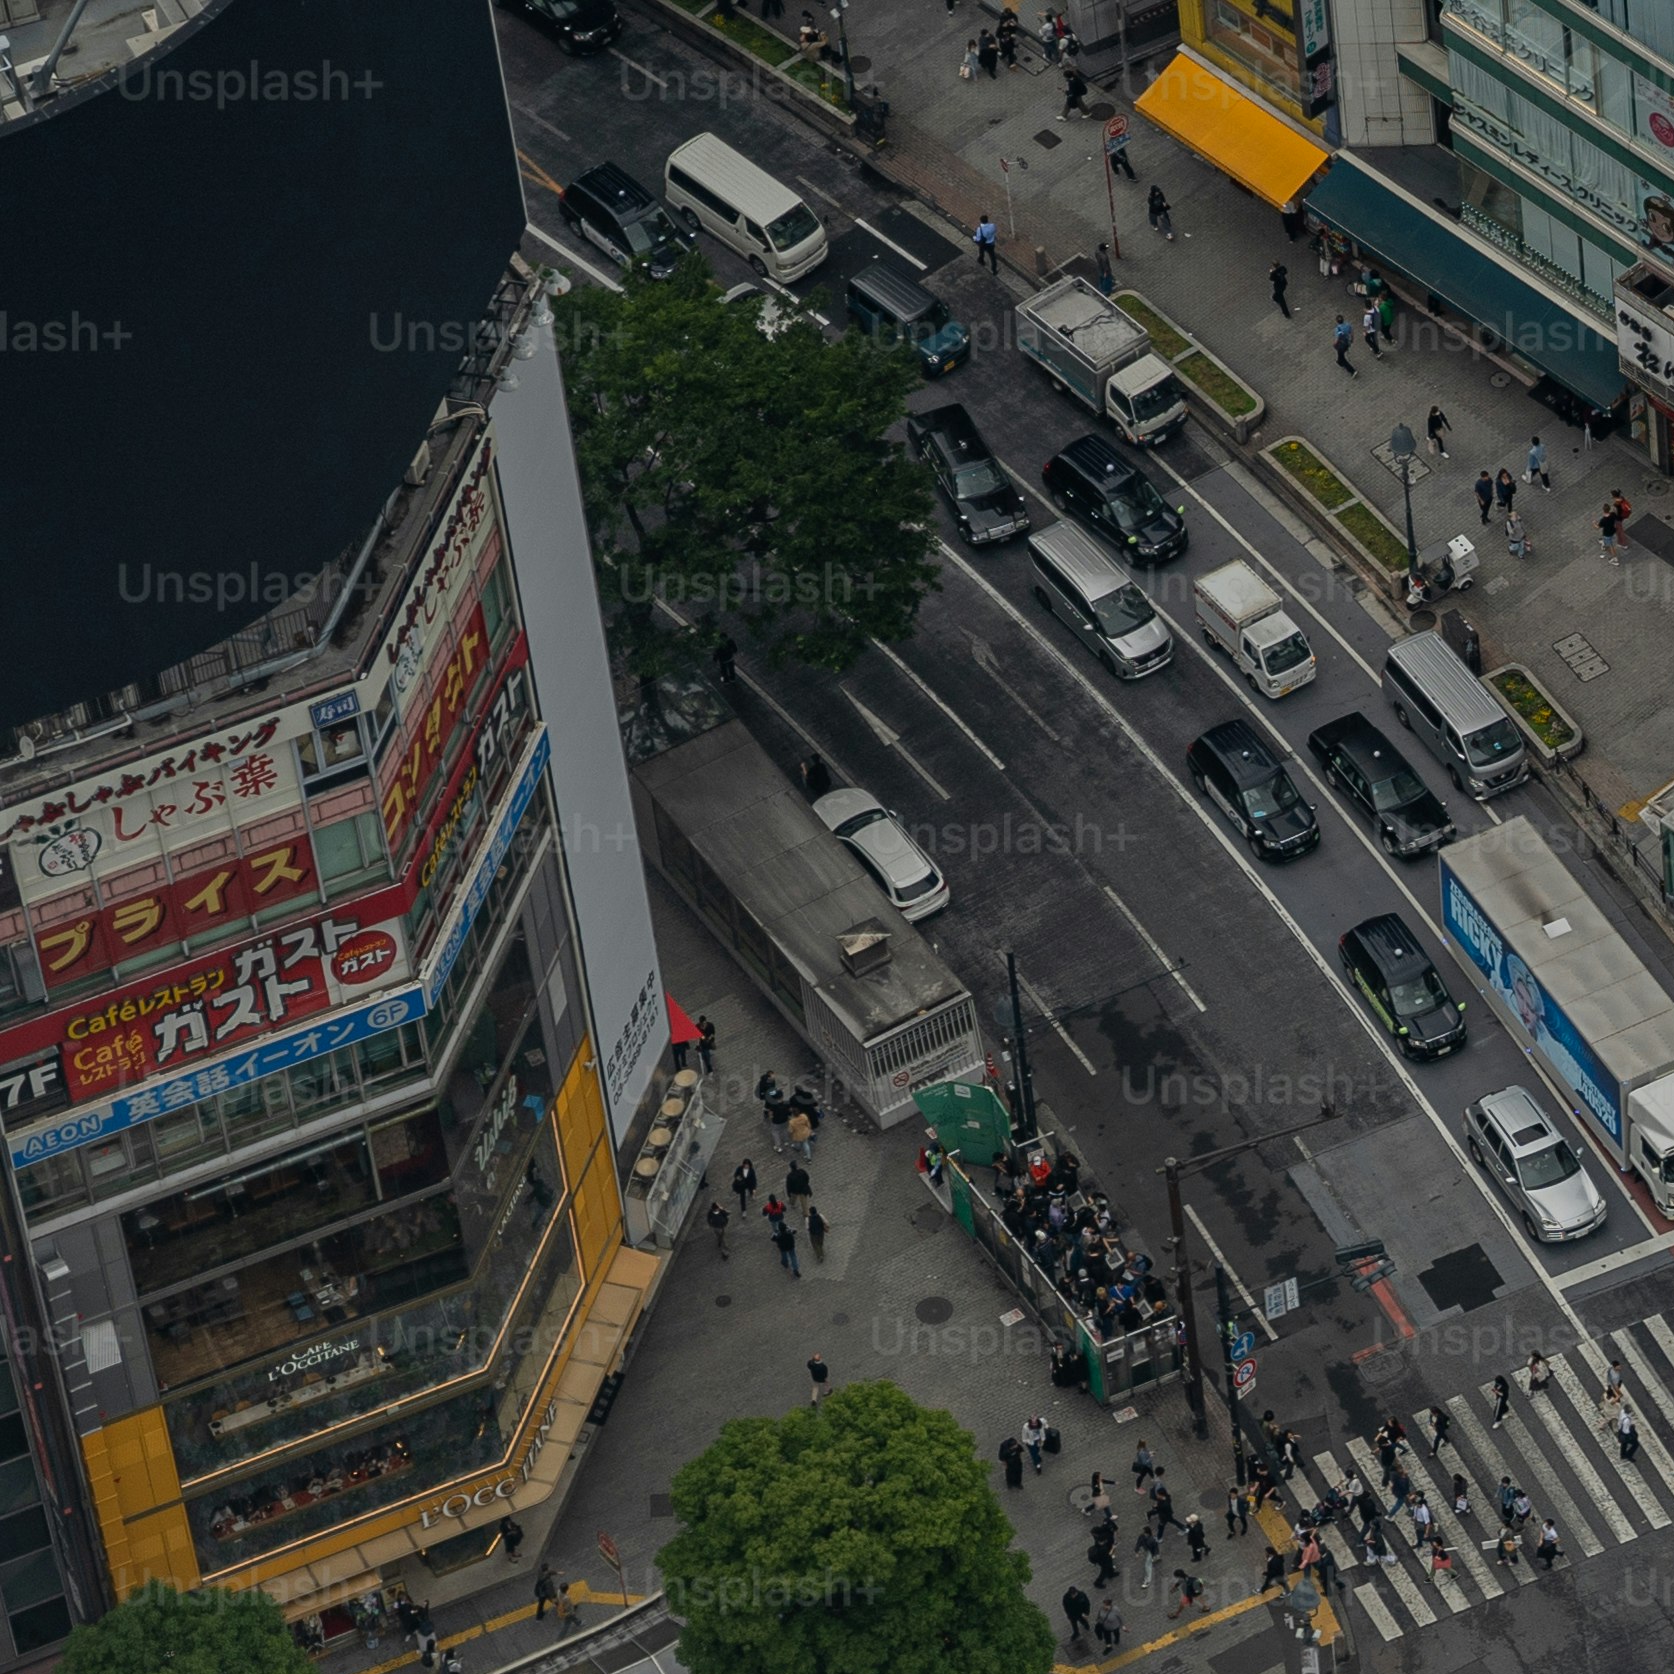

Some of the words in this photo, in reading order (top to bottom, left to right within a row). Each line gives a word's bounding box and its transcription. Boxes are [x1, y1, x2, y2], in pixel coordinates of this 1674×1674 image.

[0, 717, 279, 842] ゃぶしゃぶバイキング
[111, 753, 278, 841] しゃぶ葉
[40, 847, 303, 972] プライス
[1450, 890, 1503, 967] RICKY
[235, 917, 358, 987] ガスト
[340, 946, 391, 976] ガスト
[74, 1029, 143, 1070] Café
[154, 975, 309, 1062] ガスト
[1, 1063, 57, 1109] 7F
[126, 1020, 356, 1122] 英会話イーオン
[371, 1003, 405, 1027] 6F
[23, 1114, 101, 1158] AEON
